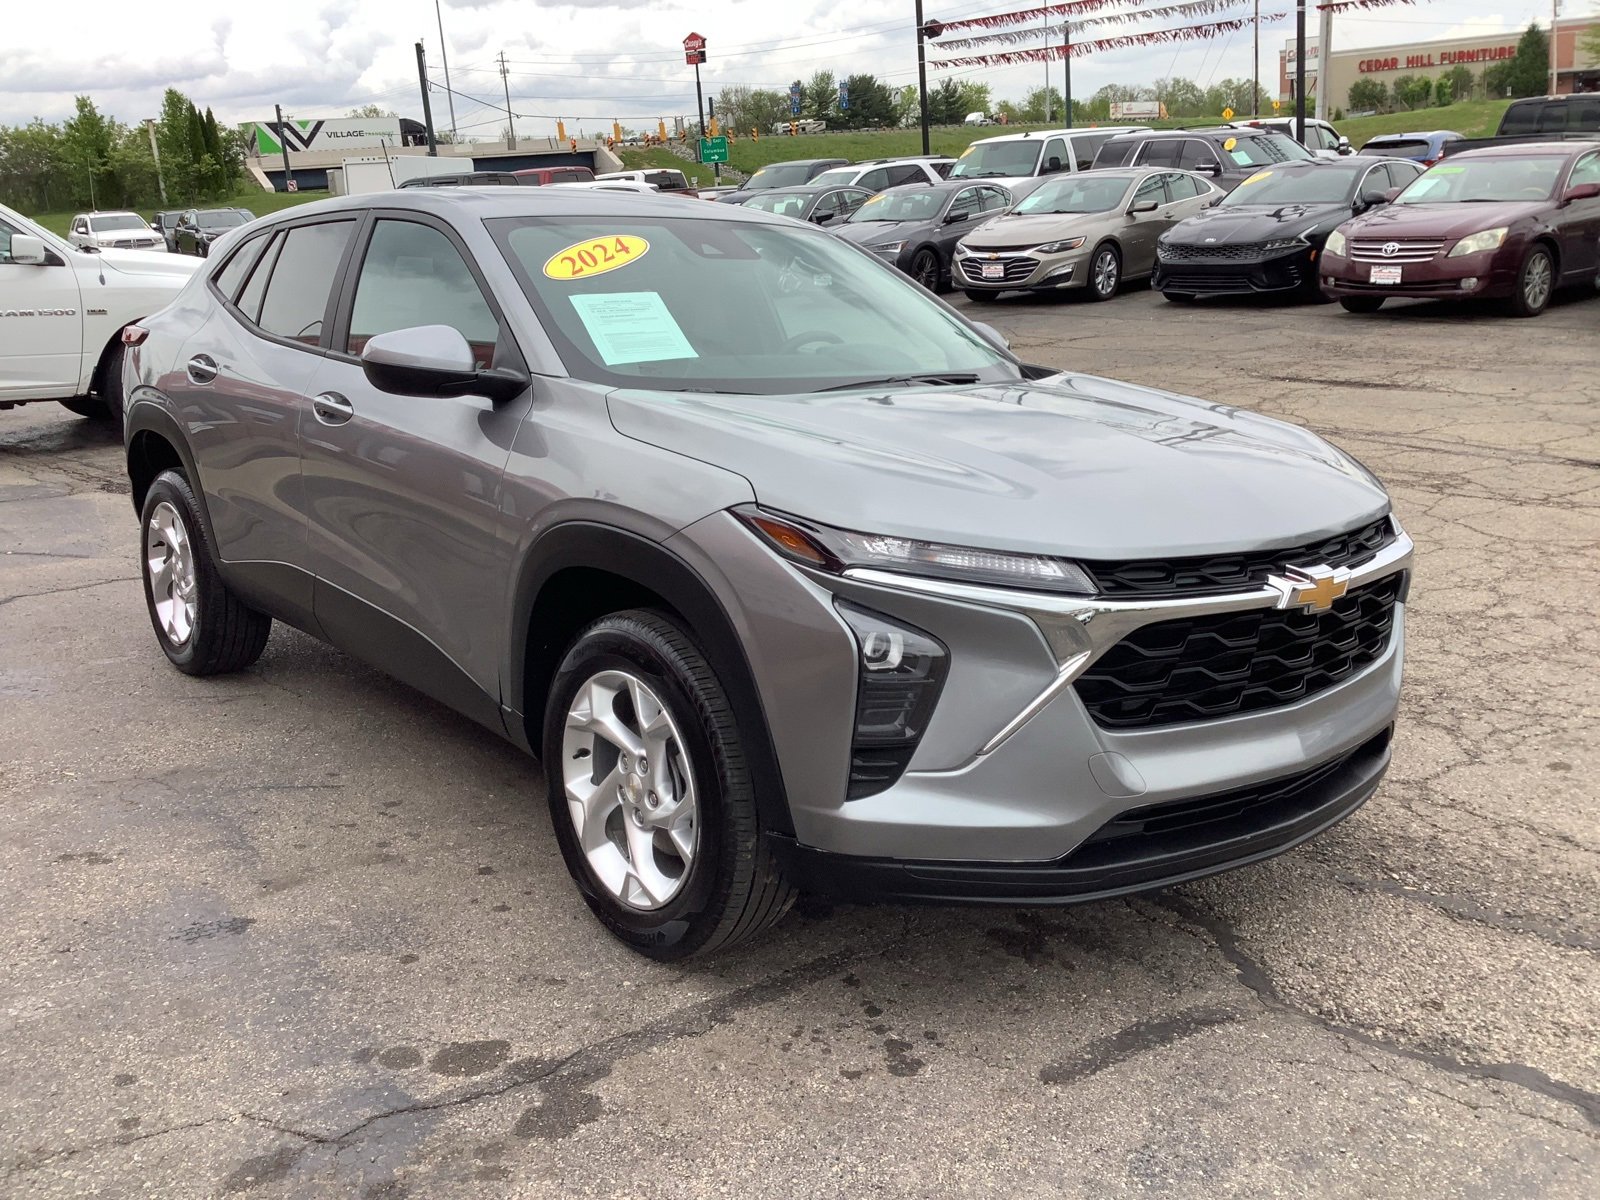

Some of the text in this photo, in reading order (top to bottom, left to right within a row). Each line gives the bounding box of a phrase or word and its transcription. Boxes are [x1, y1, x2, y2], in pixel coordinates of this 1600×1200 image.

[1359, 45, 1516, 73] CEDAR HILL FURNITURE
[325, 130, 364, 138] VILLAGE
[560, 237, 631, 276] 2024
[37, 308, 76, 317] 1500
